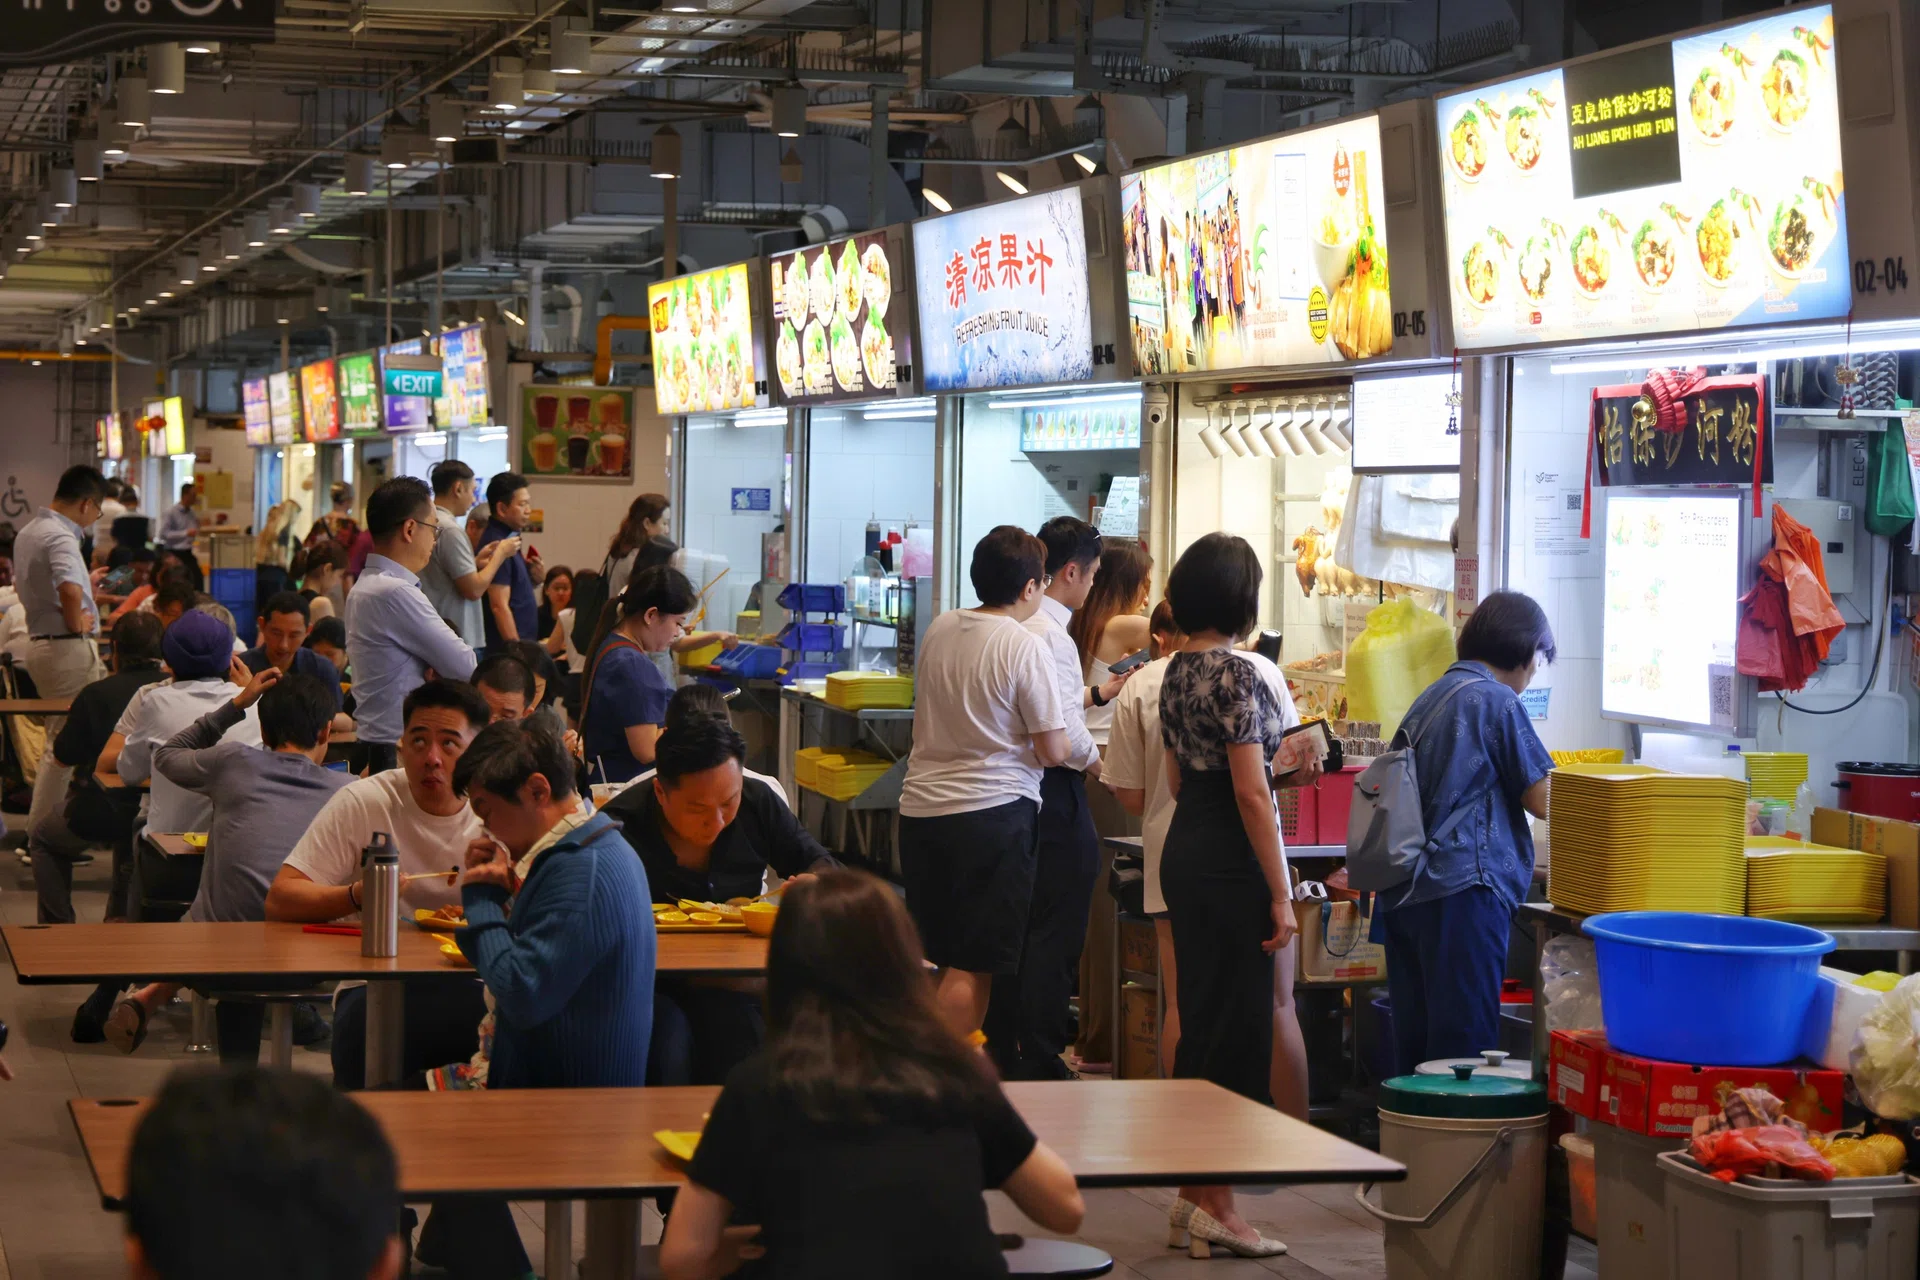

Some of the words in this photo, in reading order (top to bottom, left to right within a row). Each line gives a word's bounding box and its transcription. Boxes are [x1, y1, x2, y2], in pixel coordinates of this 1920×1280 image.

[1571, 87, 1672, 126] 亞良怡保沙河粉
[1573, 135, 1584, 150] AH
[1586, 130, 1609, 147] LIANG
[1611, 126, 1631, 142] IPOH
[1633, 122, 1652, 138] HOR
[1655, 117, 1675, 134] FUN
[945, 233, 1053, 308] 清凉果汁
[1855, 256, 1908, 292] 02-04
[956, 312, 1000, 346] REFRESHING
[1000, 310, 1023, 331] FRUIT
[1025, 313, 1049, 338] JUICE
[1394, 310, 1425, 337] 02-05
[402, 374, 435, 394] EXIT
[1455, 558, 1477, 571] DESSERTS
